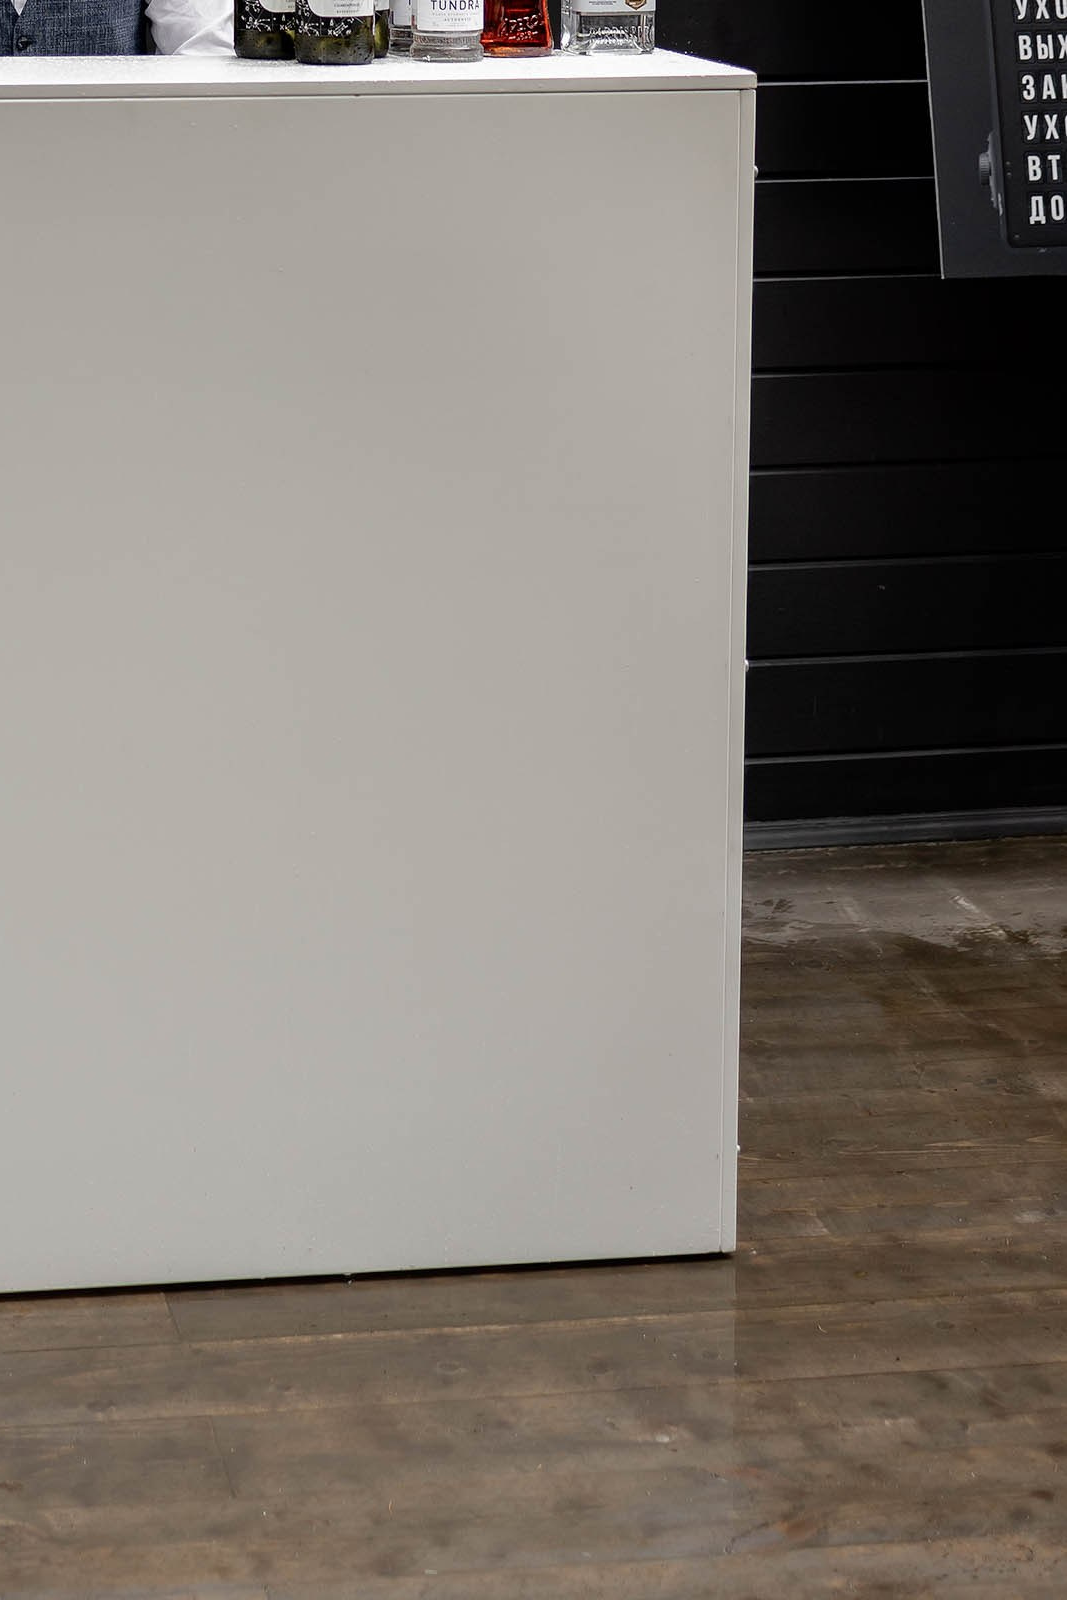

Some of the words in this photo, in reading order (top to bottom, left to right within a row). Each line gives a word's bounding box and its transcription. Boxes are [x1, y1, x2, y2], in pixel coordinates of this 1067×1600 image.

[430, 0, 480, 11] TUNDRA
[1023, 114, 1067, 141] УХ
[1027, 154, 1061, 181] ВТ
[1029, 194, 1065, 225] ДО
